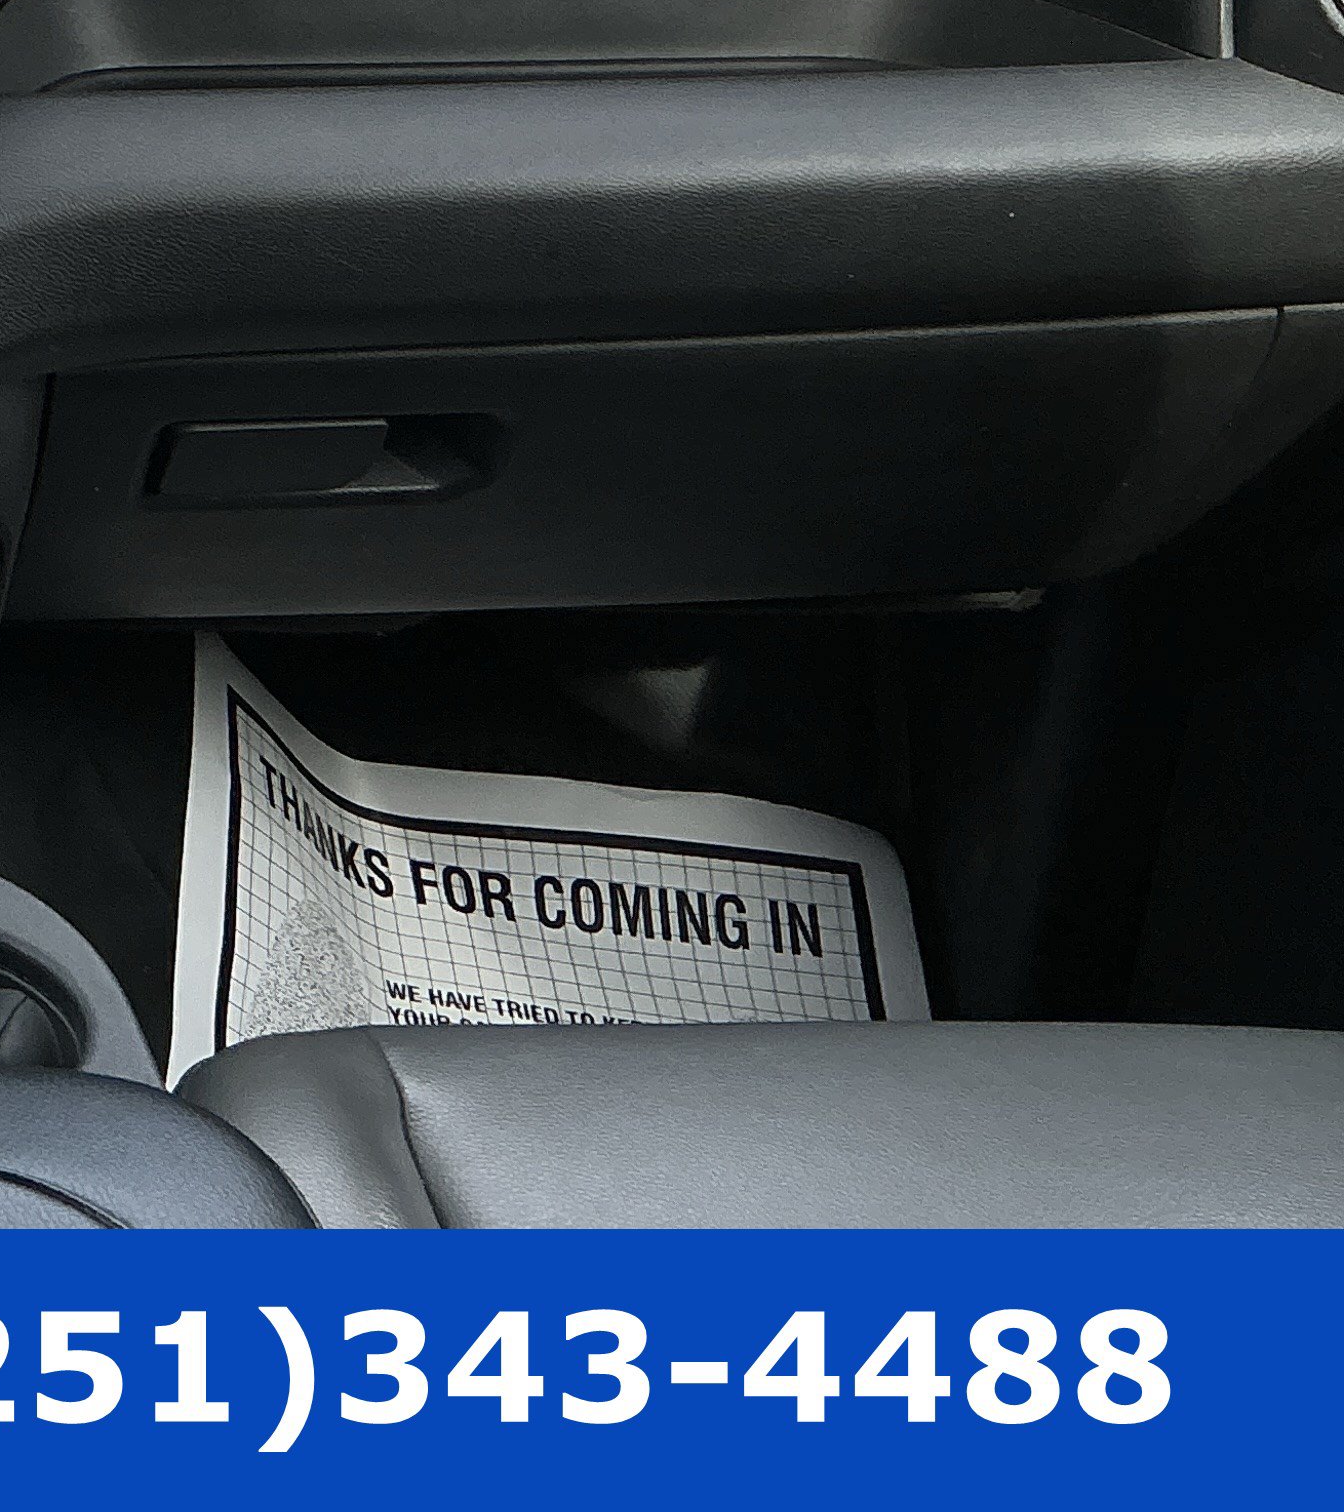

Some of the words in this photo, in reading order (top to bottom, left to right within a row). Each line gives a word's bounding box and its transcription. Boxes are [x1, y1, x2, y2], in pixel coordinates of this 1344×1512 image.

[258, 754, 395, 900] THANKS
[410, 859, 517, 923] FOR
[534, 874, 752, 952] COMING
[768, 901, 825, 959] IN
[385, 979, 421, 1004] WE
[427, 988, 488, 1014] HAVE
[492, 997, 561, 1026] TRIED
[564, 1010, 596, 1025] TO
